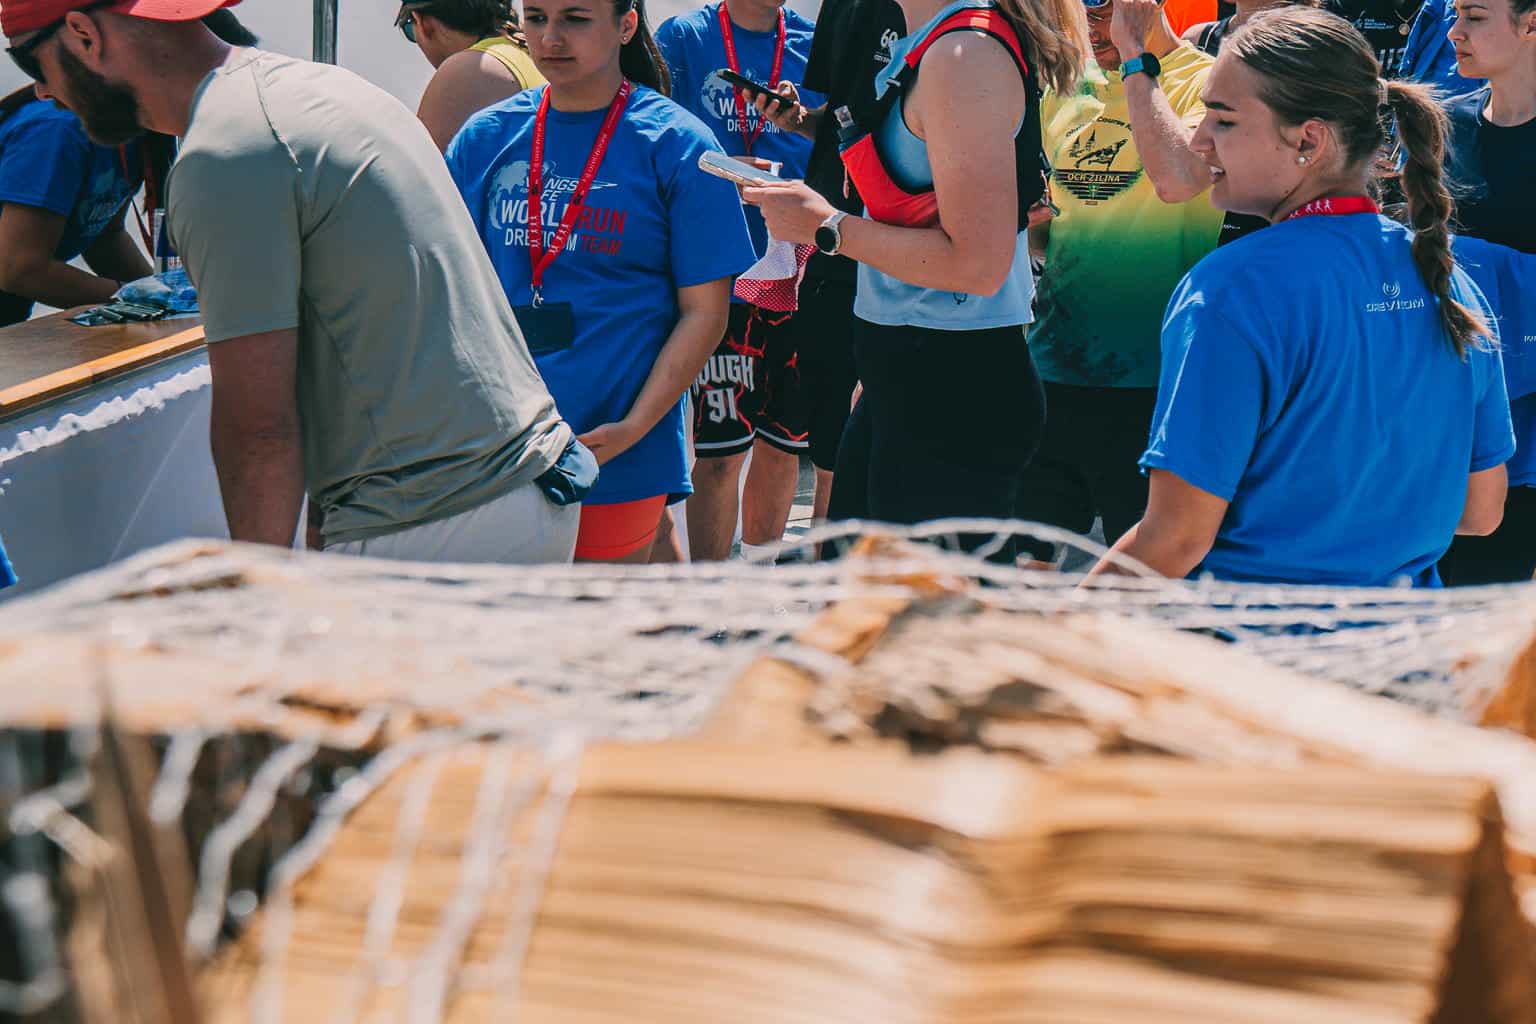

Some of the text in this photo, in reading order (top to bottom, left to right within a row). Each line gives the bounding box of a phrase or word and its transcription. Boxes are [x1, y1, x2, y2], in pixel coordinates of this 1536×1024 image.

[577, 205, 627, 235] RUN
[504, 228, 623, 255] DREICM TEAM
